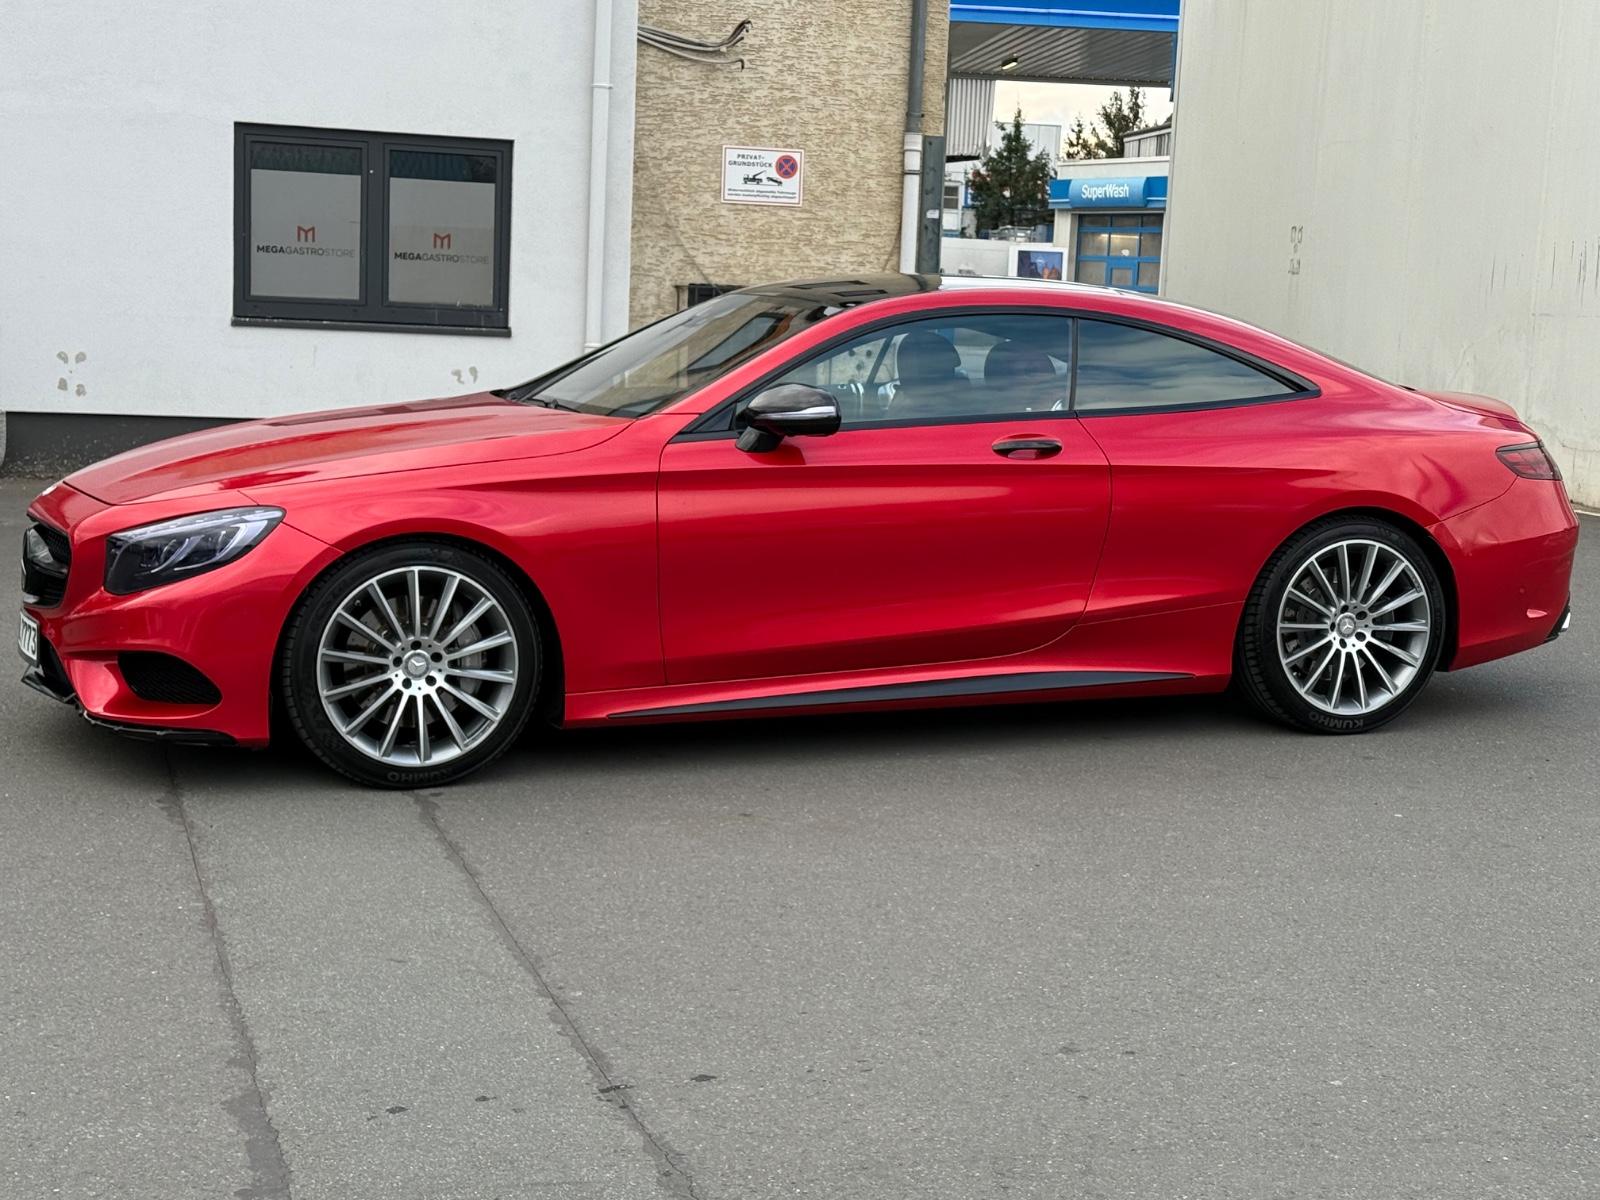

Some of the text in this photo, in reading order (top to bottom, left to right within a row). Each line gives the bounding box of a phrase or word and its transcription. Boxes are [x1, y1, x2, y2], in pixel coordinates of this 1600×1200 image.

[737, 153, 765, 161] PRIVAT-
[728, 160, 773, 168] GRUNDSTÜCK
[1081, 183, 1129, 201] SuperWash
[1308, 711, 1364, 729] KUMHO
